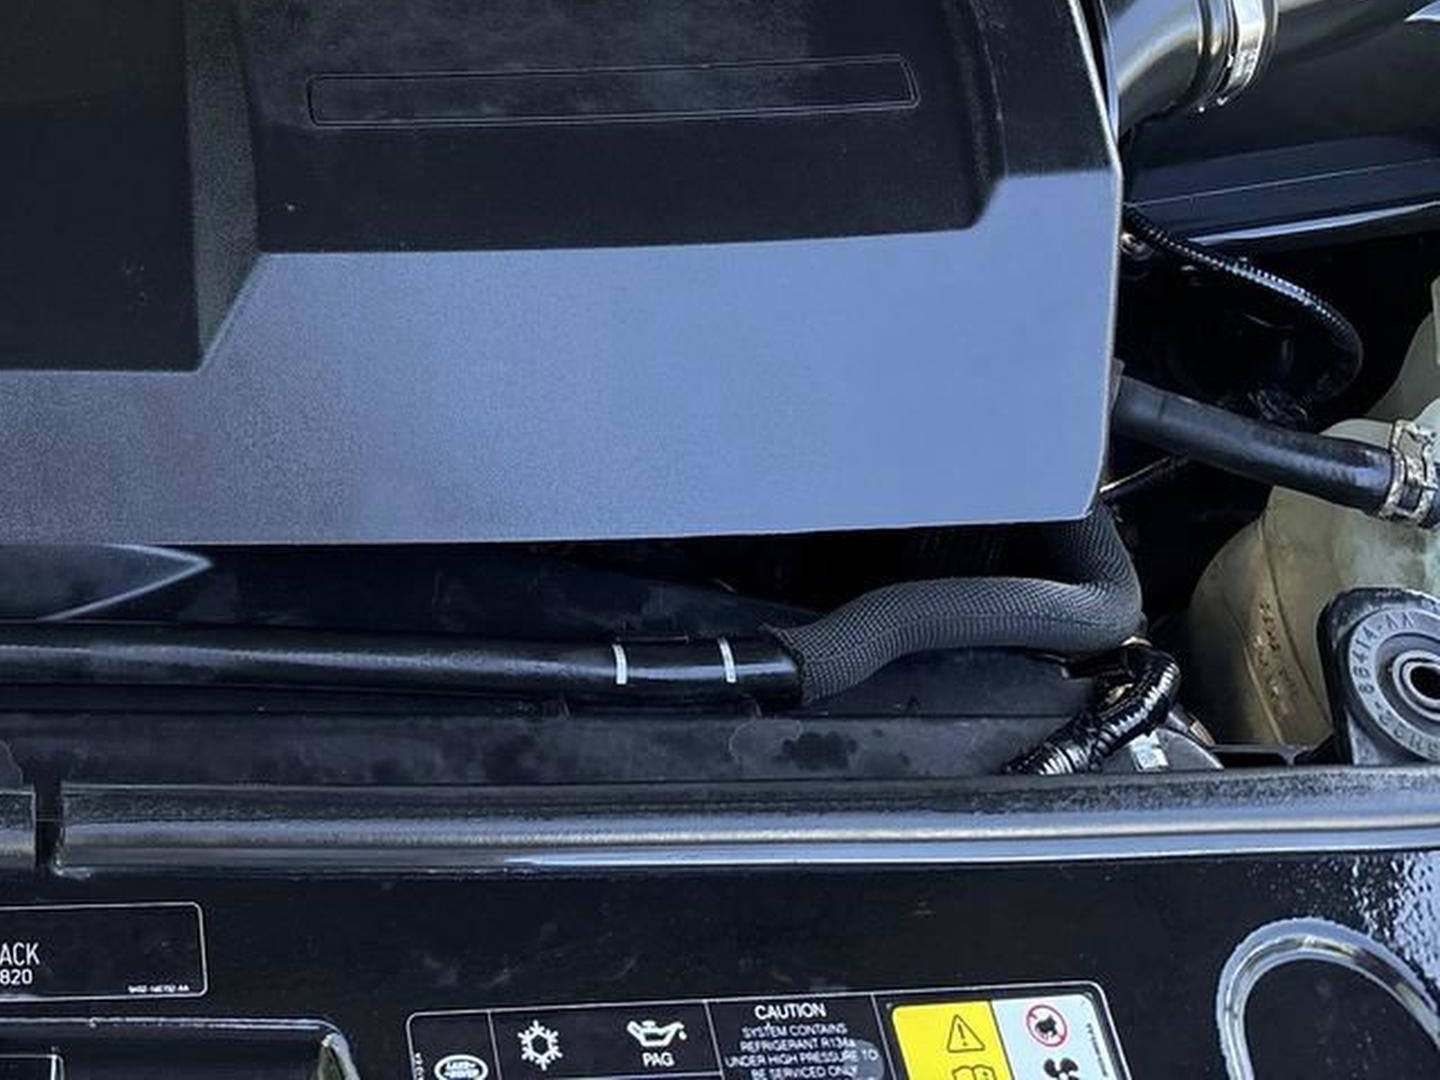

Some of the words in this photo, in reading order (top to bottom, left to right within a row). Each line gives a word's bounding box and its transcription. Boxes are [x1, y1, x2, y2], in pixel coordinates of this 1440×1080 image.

[0, 967, 33, 986] 820
[754, 1002, 826, 1020] CAUTION
[742, 1022, 787, 1038] SYSTEM
[789, 1022, 848, 1036] CONTAINS
[740, 1037, 818, 1053] REFRIGERANT
[642, 1051, 675, 1067] PAG
[724, 1054, 766, 1068] UNDER
[768, 1053, 798, 1065] HIGH
[800, 1050, 858, 1064] PRESSURE
[861, 1048, 879, 1061] TO
